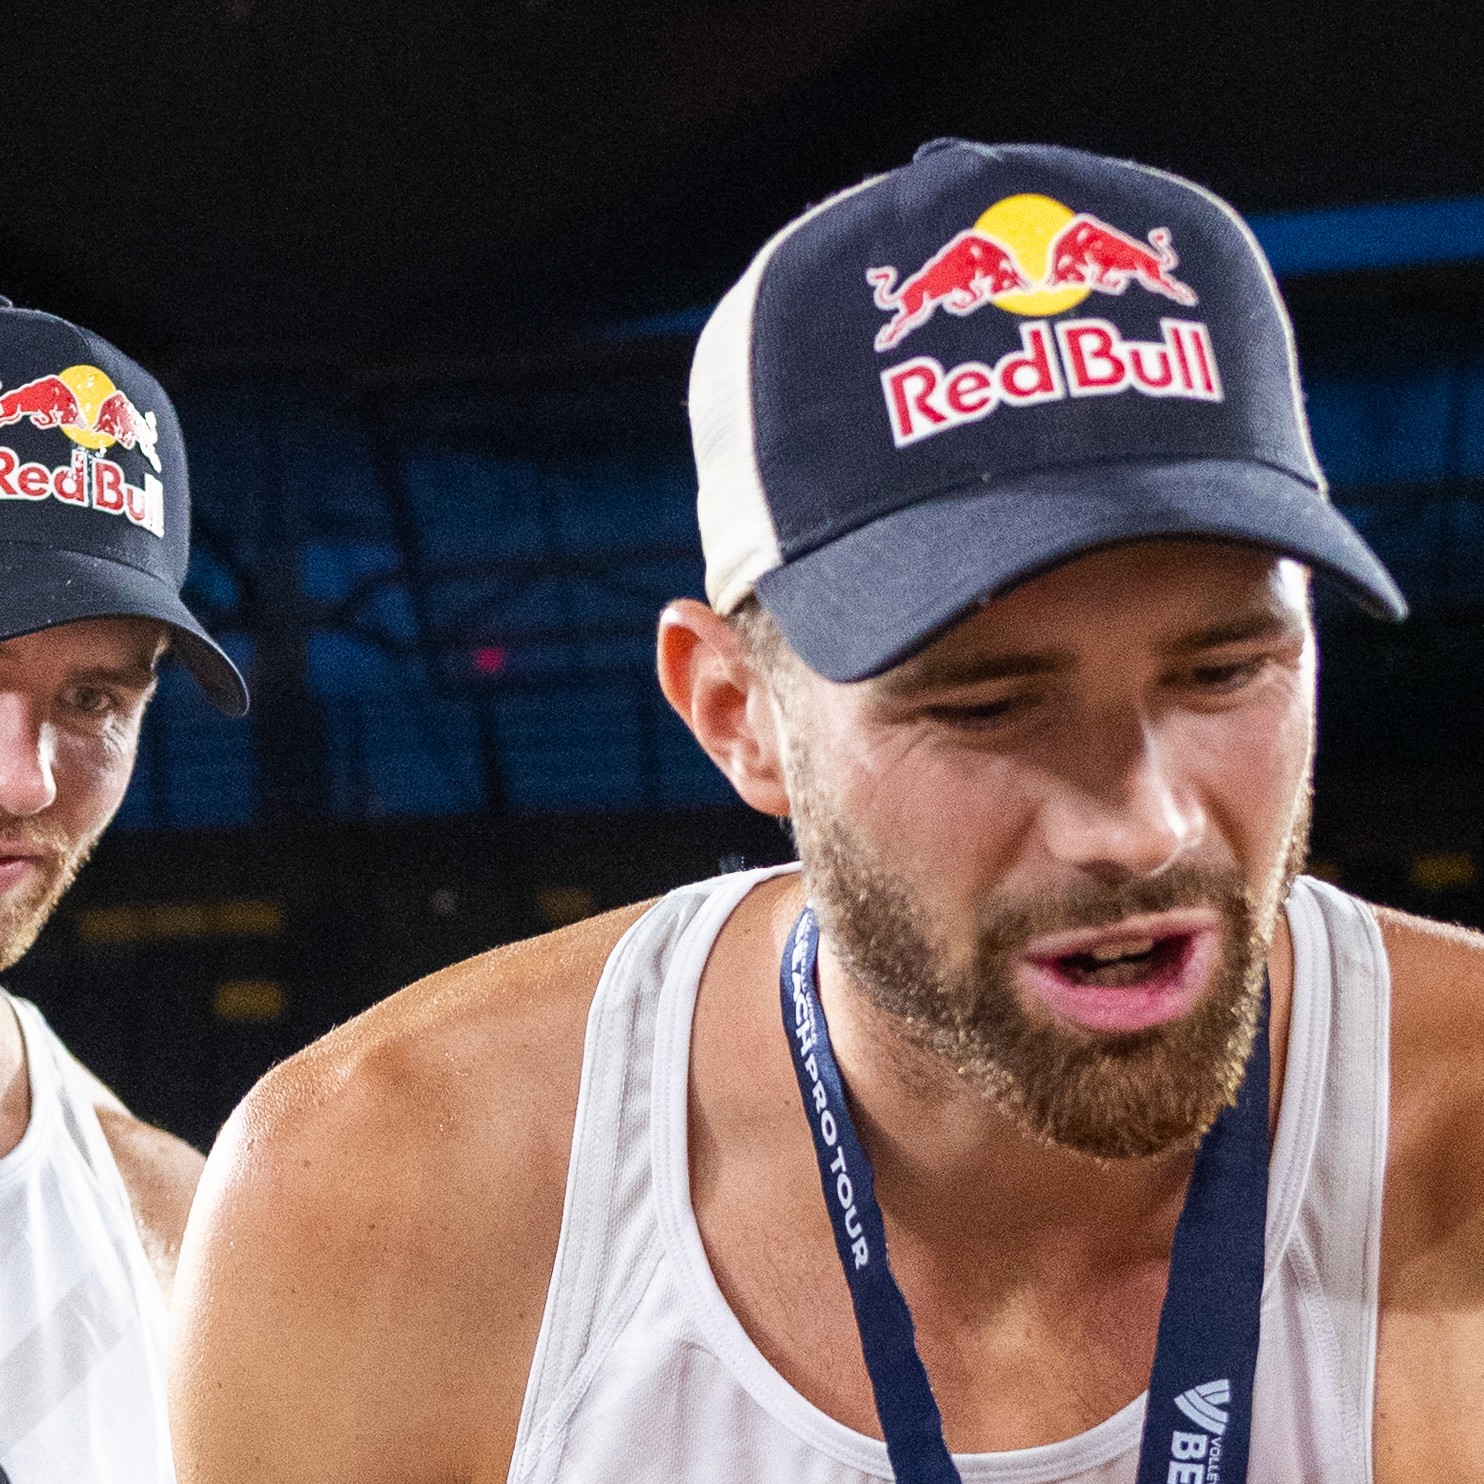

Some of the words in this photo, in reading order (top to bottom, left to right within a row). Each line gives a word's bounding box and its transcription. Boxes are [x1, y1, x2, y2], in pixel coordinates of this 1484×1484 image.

[884, 322, 1060, 443] Red
[1059, 320, 1219, 399] Bull
[94, 460, 163, 535] Bu
[805, 1053, 837, 1146] PRO
[830, 1146, 869, 1271] TOUR
